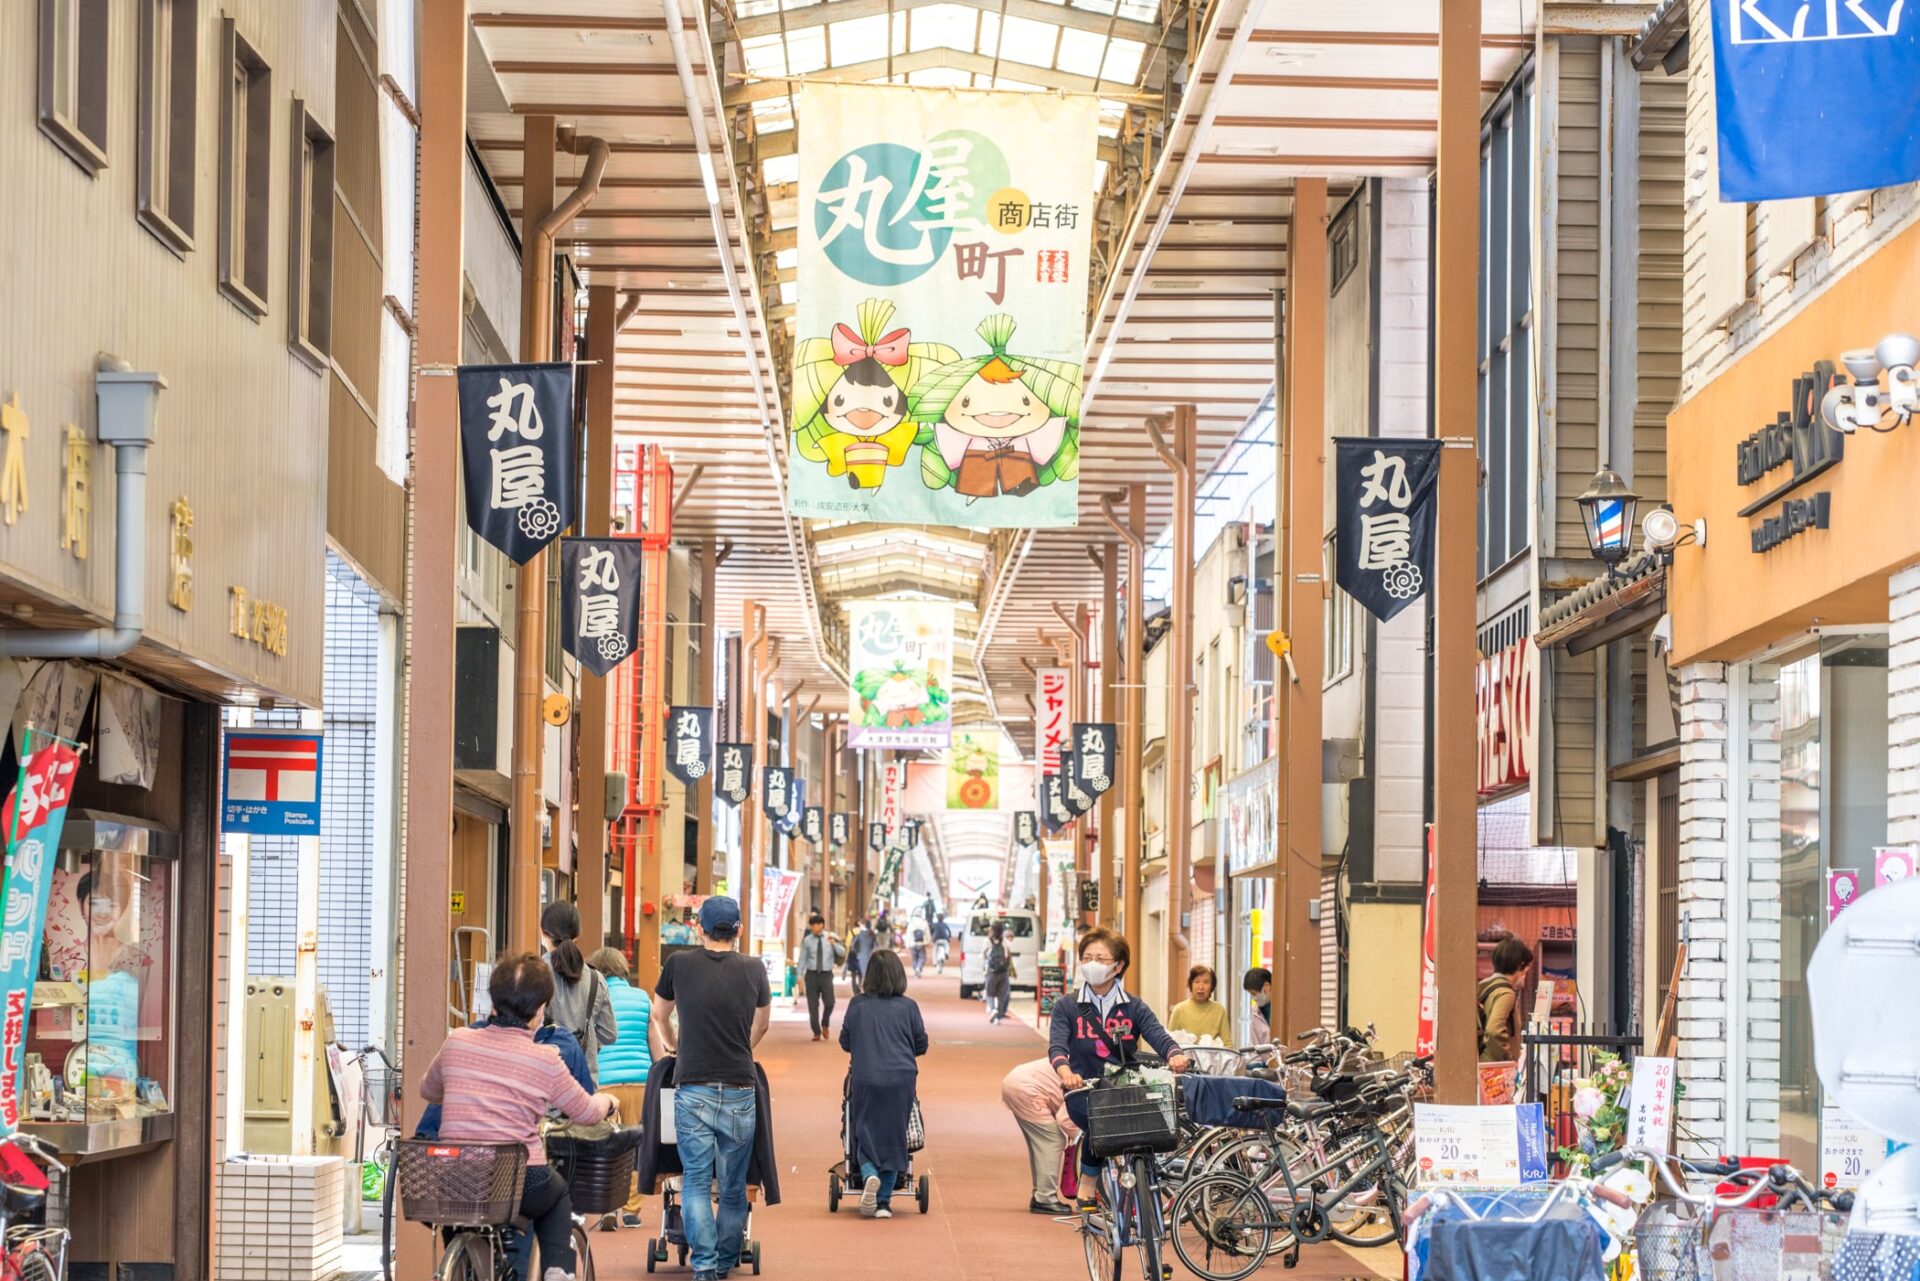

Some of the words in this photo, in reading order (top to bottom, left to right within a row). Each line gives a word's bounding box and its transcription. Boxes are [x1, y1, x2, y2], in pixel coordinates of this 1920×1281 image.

[998, 201, 1079, 229] 商店街
[486, 377, 545, 509] 丸屋
[1359, 449, 1412, 570] 丸屋
[579, 546, 620, 638] 丸屋
[676, 710, 702, 766] 丸屋
[1081, 727, 1106, 780] 丸屋
[722, 747, 744, 792] 丸屋
[768, 769, 786, 808] 丸屋
[1441, 1145, 1459, 1160] 20
[1824, 1148, 1864, 1156] おかげさまで
[1844, 1157, 1861, 1176] 20
